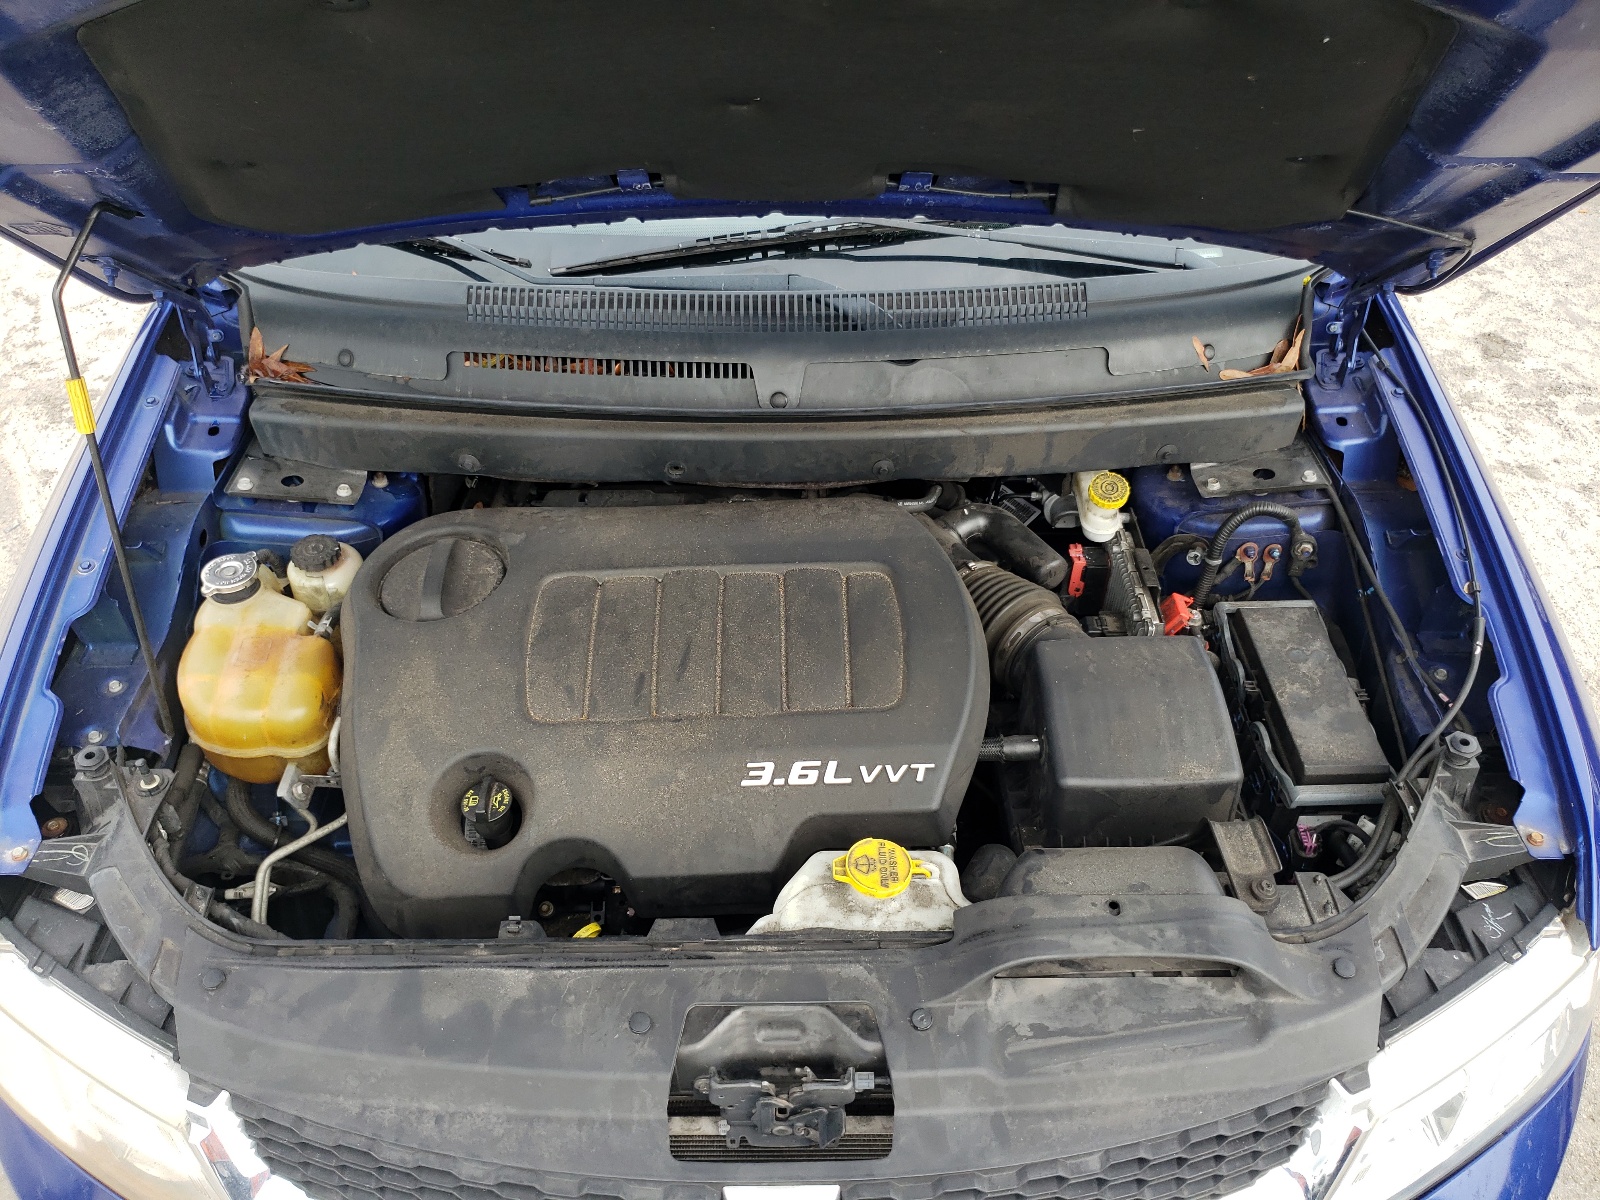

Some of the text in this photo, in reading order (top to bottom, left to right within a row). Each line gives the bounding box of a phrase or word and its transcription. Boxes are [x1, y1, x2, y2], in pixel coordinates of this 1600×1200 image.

[740, 760, 935, 786] 3.6L VVT
[877, 841, 890, 888] FLUID ONLY
[888, 847, 899, 884] WASHER
